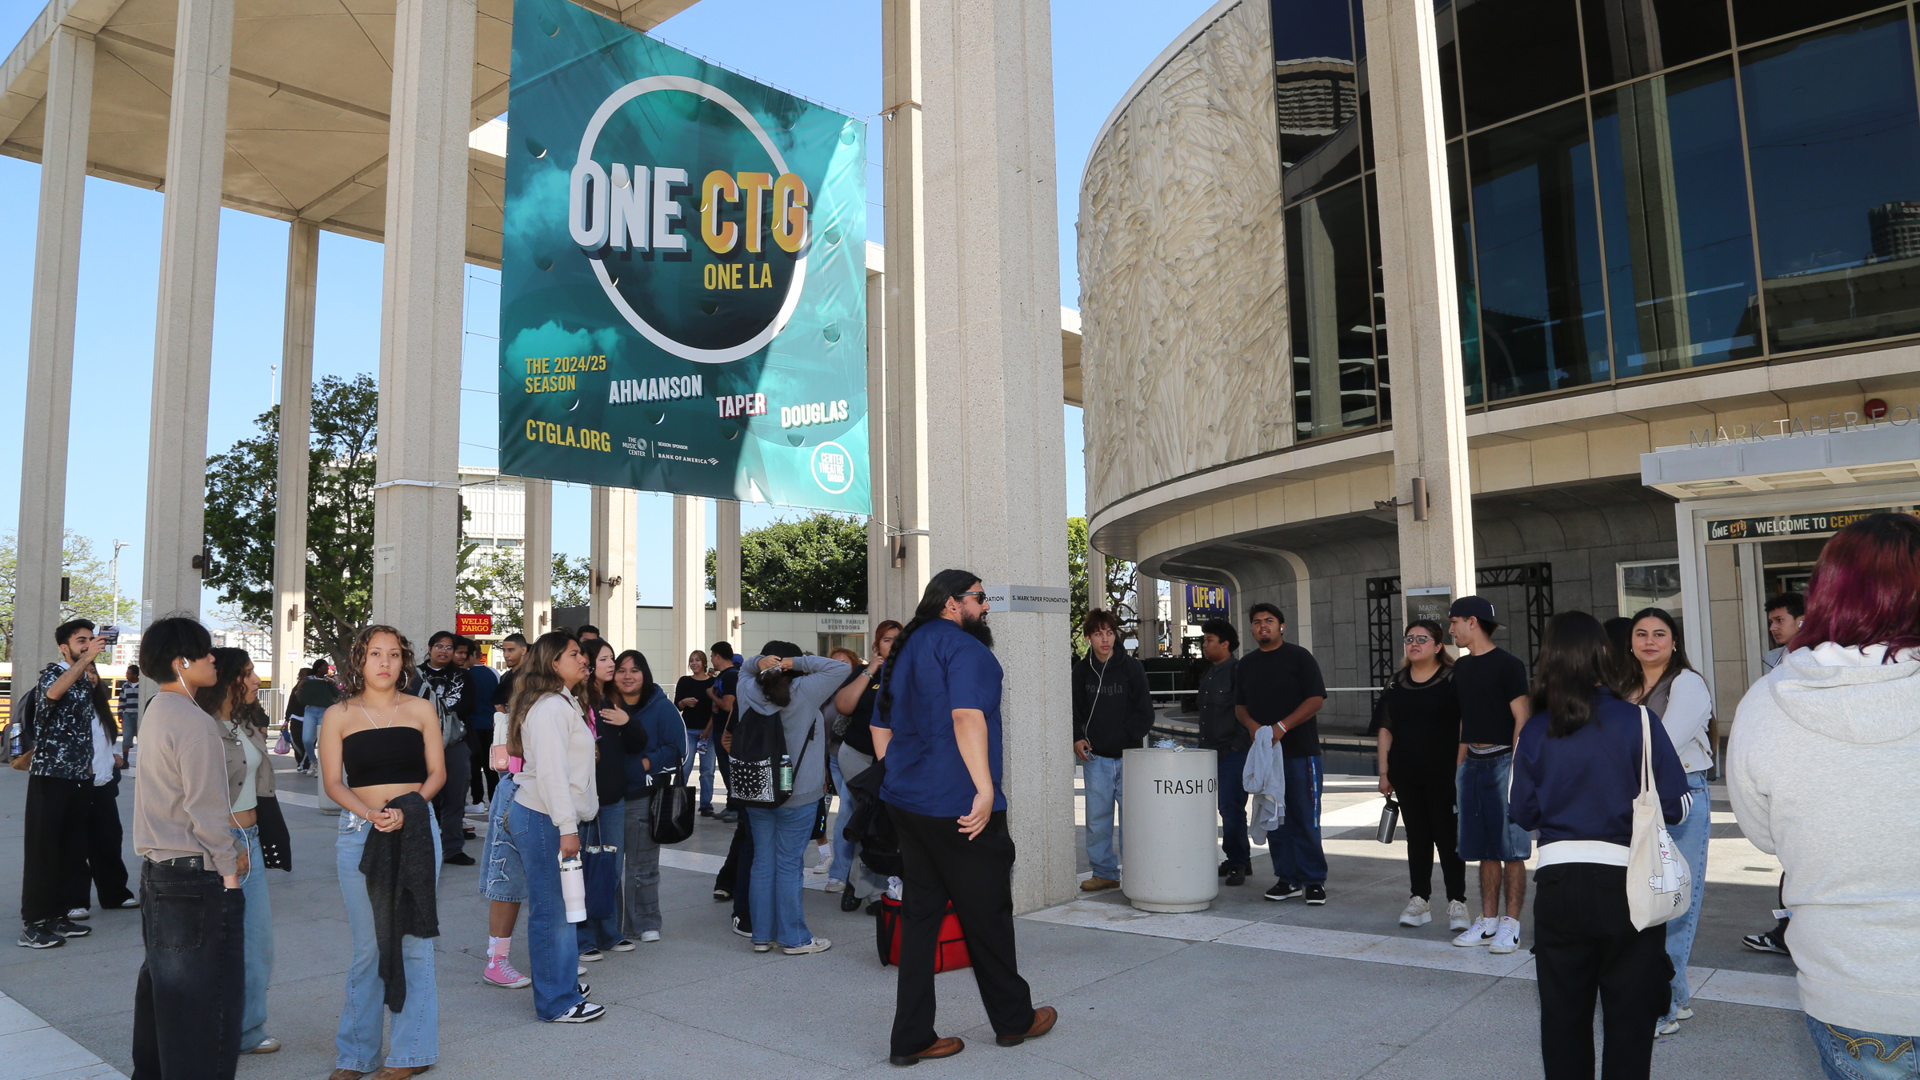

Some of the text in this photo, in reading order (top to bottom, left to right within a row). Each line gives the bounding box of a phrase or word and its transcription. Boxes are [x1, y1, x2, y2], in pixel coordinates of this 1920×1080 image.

[568, 159, 808, 253] ONE CTG
[704, 263, 773, 290] ONE LA
[525, 355, 607, 375] THE 2024/25
[525, 375, 576, 393] SEASON
[608, 374, 702, 404] AHMANSON
[716, 393, 767, 418] TAPER
[781, 400, 849, 428] DOUGLAS
[526, 419, 611, 452] CTGLA.ORG
[1690, 404, 1920, 448] MARK TAPER FO
[622, 442, 637, 450] MUSIC
[628, 449, 646, 457] CENTER
[683, 456, 708, 465] AMERICA
[818, 462, 845, 475] THEATRE
[820, 452, 844, 465] CENTER
[1711, 521, 1729, 538] ONE
[1755, 517, 1810, 534] WELCOME
[1811, 516, 1827, 529] TO
[1830, 513, 1871, 529] CENT
[1192, 586, 1225, 608] LIFE OF PI
[1153, 779, 1203, 795] TRASH
